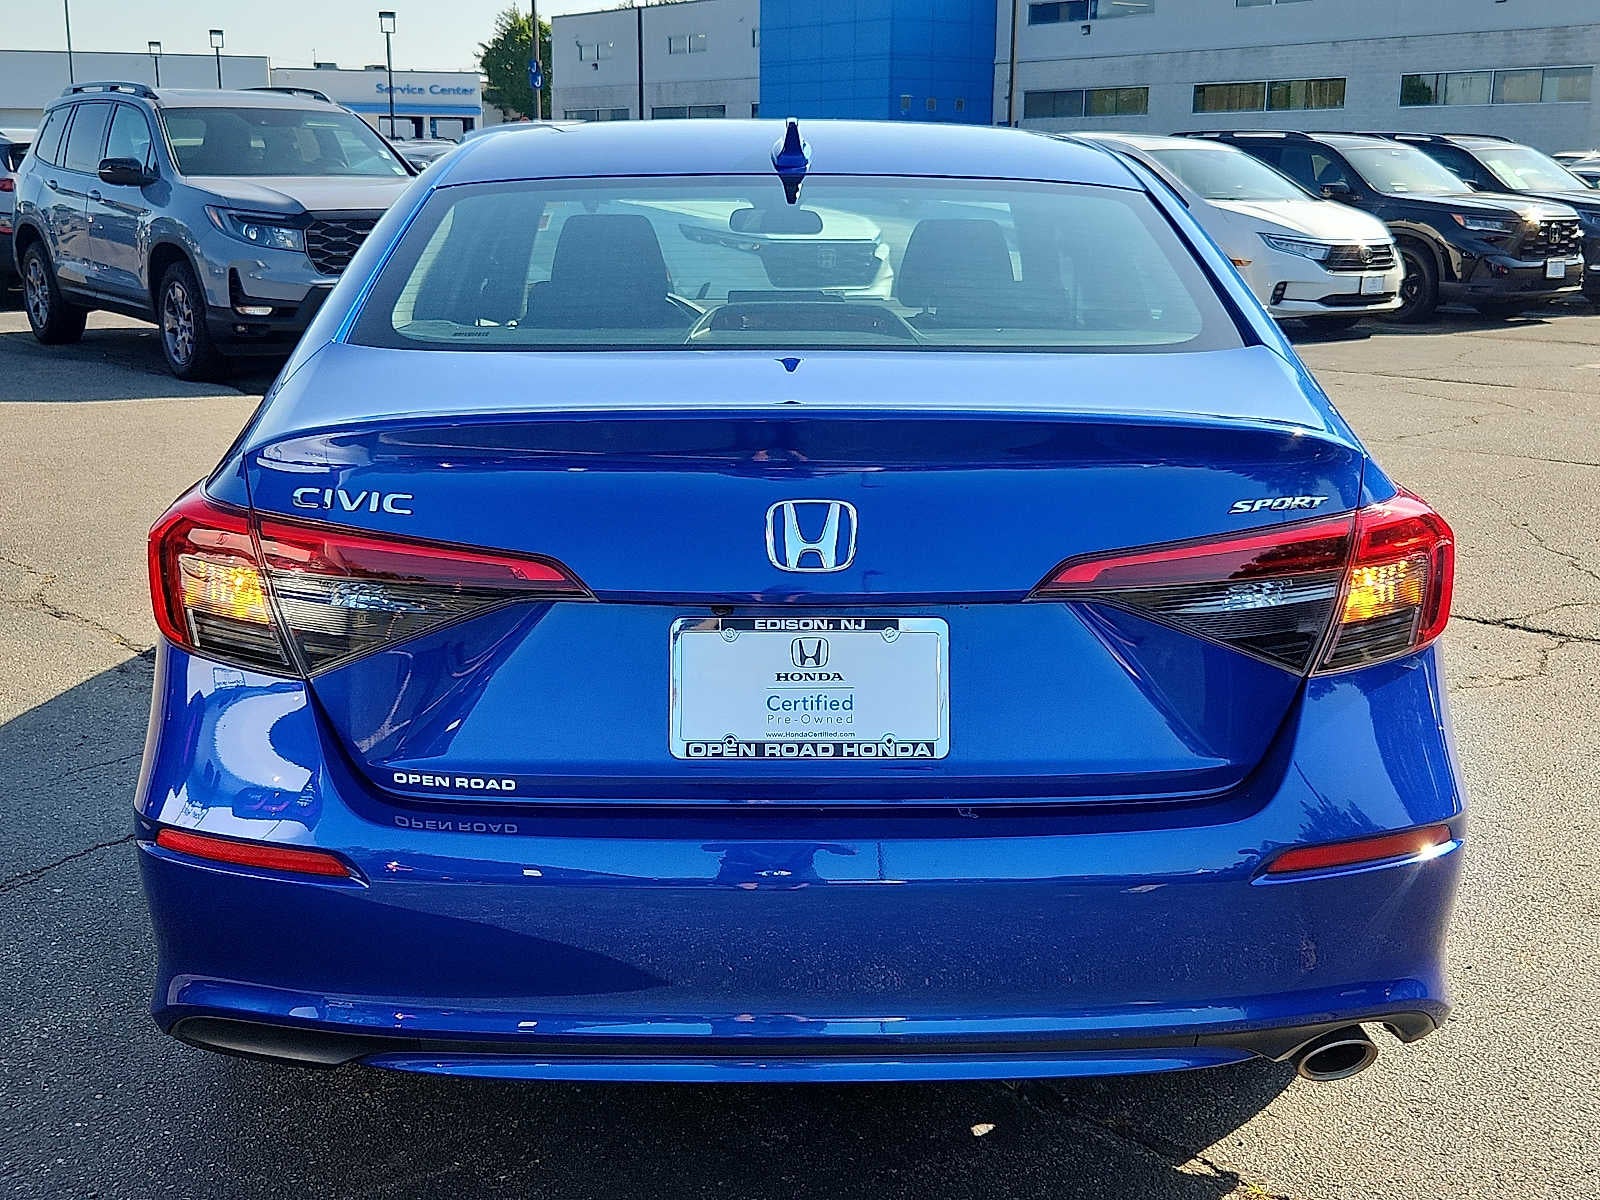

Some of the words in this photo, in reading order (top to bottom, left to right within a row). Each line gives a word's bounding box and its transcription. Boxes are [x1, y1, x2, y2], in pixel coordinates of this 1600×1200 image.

[375, 83, 425, 95] Service
[429, 84, 476, 96] Center
[292, 487, 413, 515] CIVIC
[1227, 495, 1329, 514] SPORT
[754, 619, 834, 631] EDISON,
[840, 619, 866, 631] NJ
[775, 672, 845, 682] HONDA
[766, 694, 854, 712] Certified
[767, 714, 854, 725] Pre-Owned
[688, 743, 756, 757] OPEN
[764, 743, 835, 757] ROAD
[842, 743, 932, 757] HONDA
[393, 772, 450, 788] OPEN
[455, 777, 516, 791] ROAD
